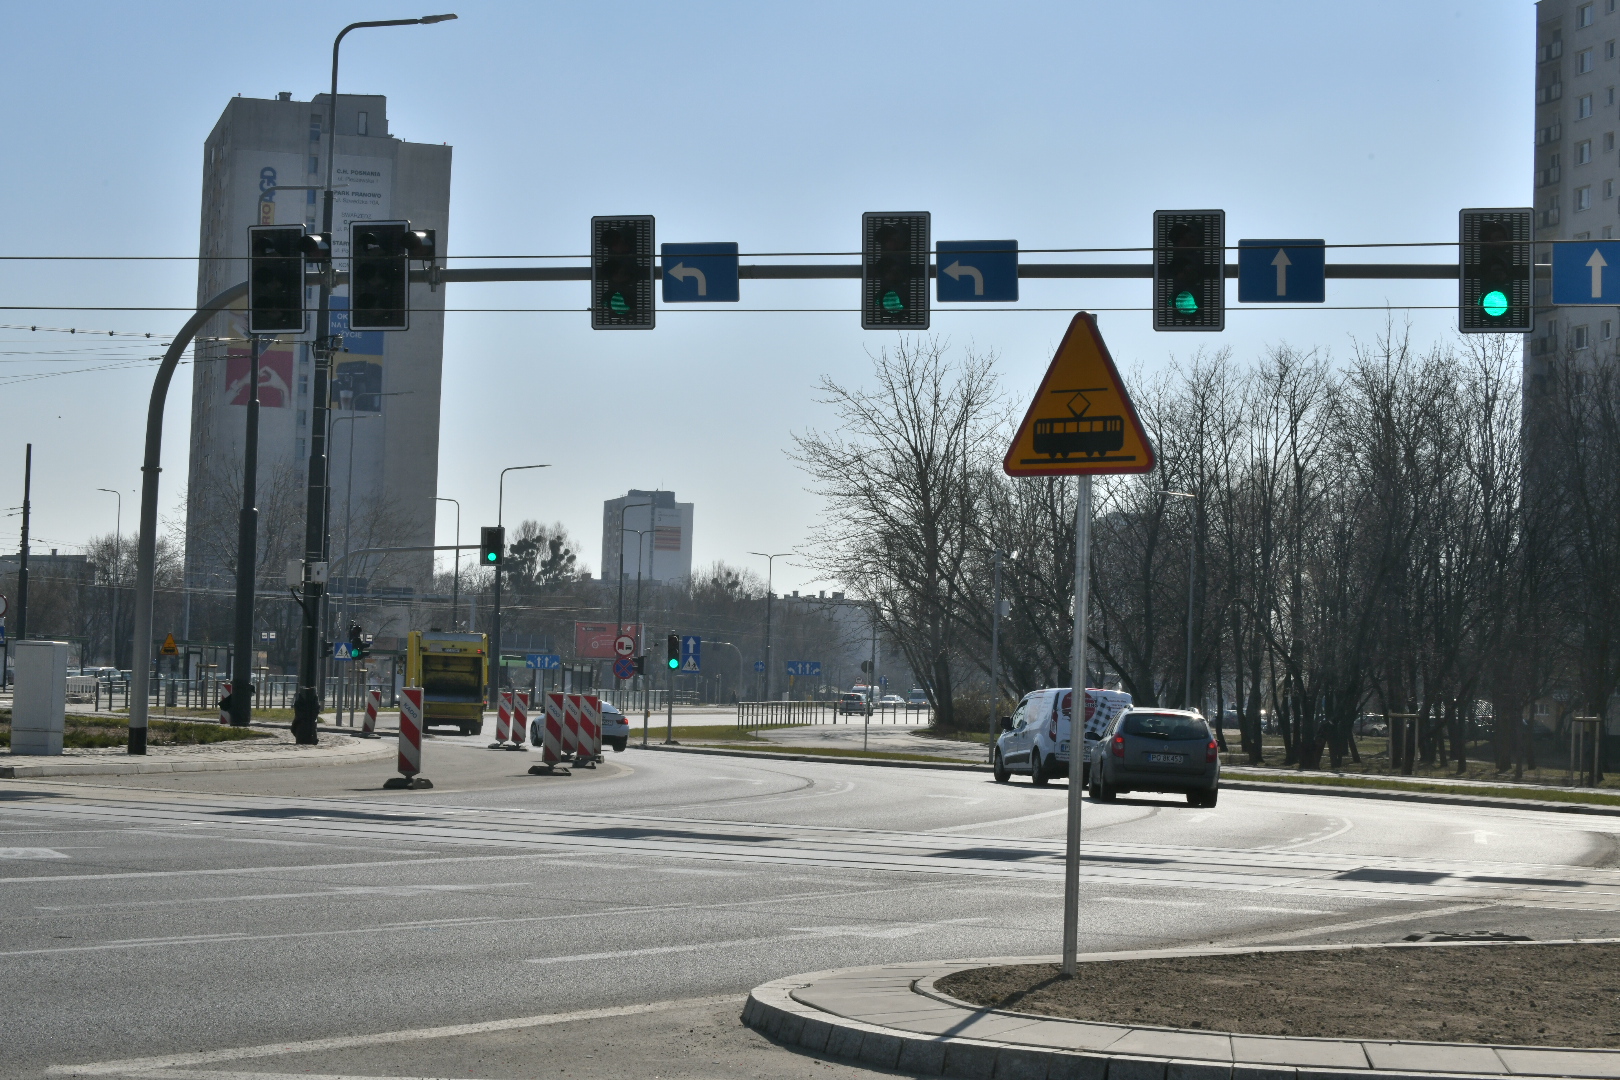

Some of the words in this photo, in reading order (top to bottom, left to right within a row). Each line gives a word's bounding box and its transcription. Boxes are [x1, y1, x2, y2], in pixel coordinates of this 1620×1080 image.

[259, 166, 276, 202] AGD
[262, 204, 271, 225] RO
[403, 702, 418, 719] KADO
